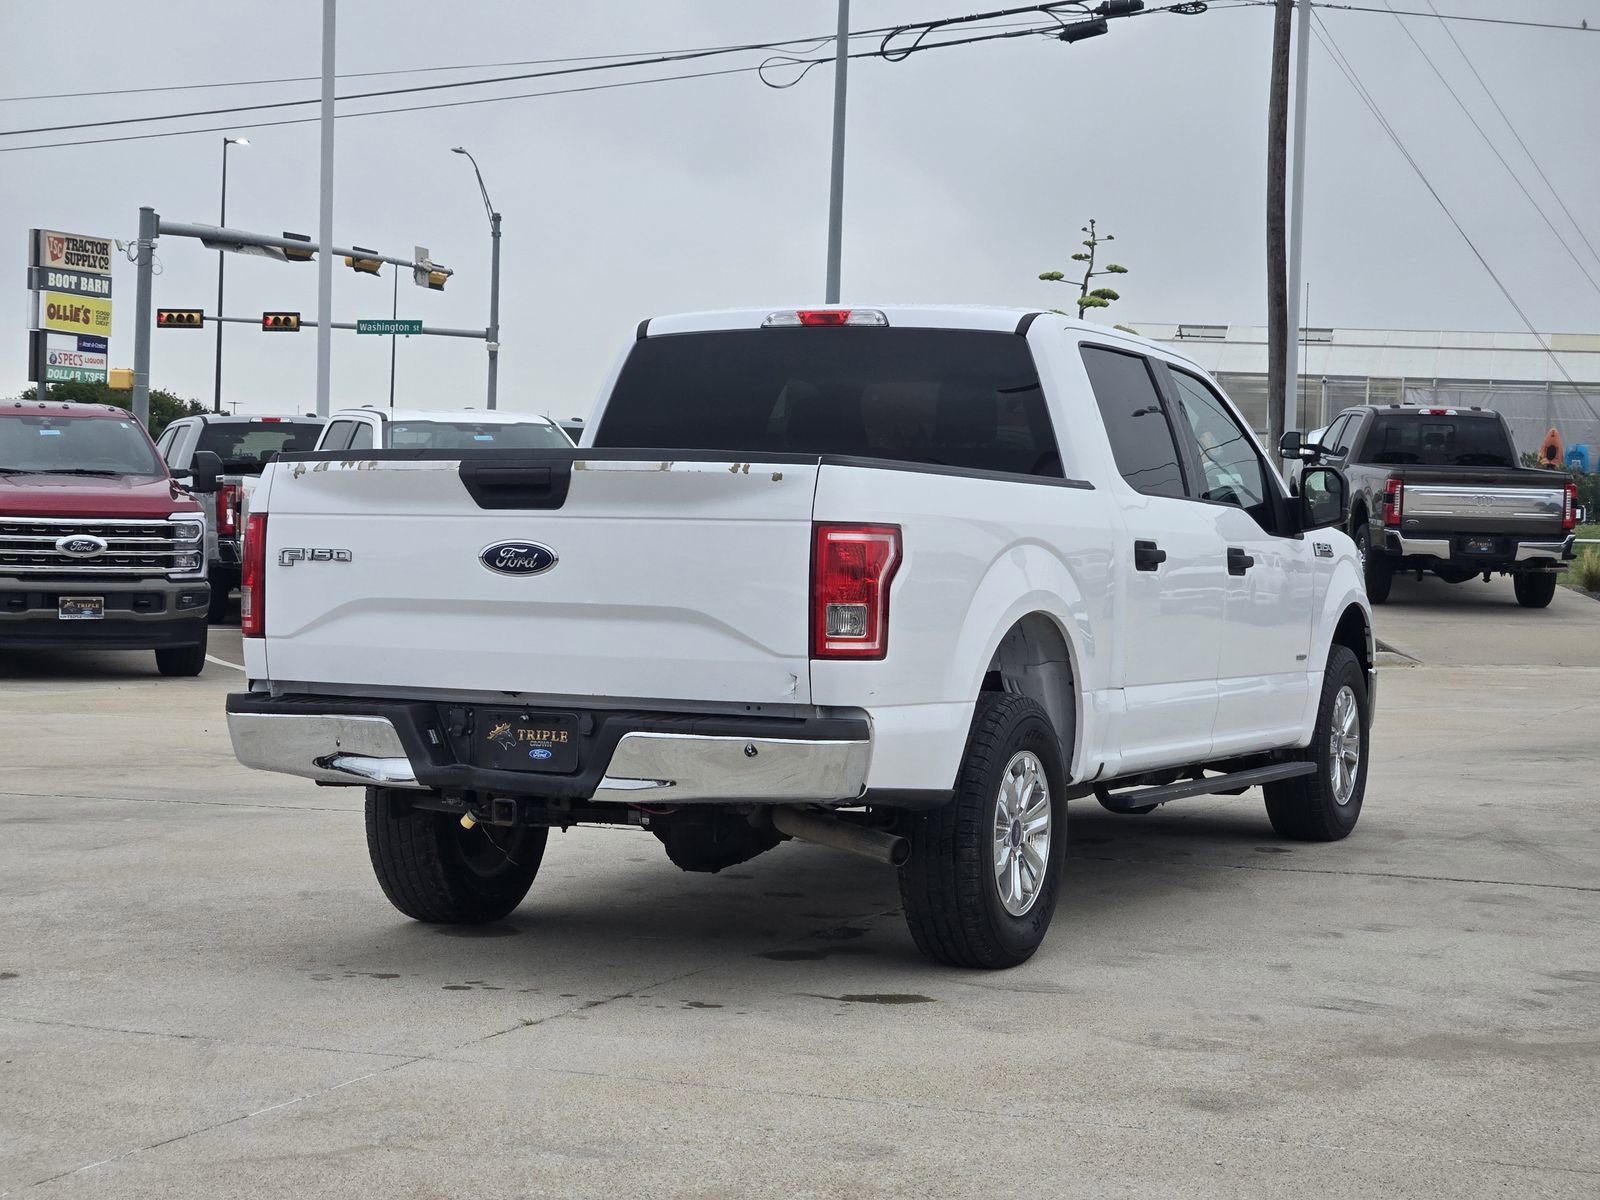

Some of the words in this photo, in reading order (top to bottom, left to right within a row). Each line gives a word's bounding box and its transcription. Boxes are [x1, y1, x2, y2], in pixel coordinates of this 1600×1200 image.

[48, 237, 62, 257] TSC
[65, 237, 109, 255] TRACTOR
[48, 272, 77, 289] BOOT
[80, 276, 109, 294] BARN
[360, 322, 409, 333] Washington
[58, 352, 83, 366] SPEC'S
[84, 357, 104, 365] LIQUOR
[47, 368, 81, 381] DOLLAR
[84, 371, 106, 382] TREE
[70, 540, 95, 551] Ford
[495, 547, 538, 569] Ford
[517, 729, 568, 743] TRIPLE
